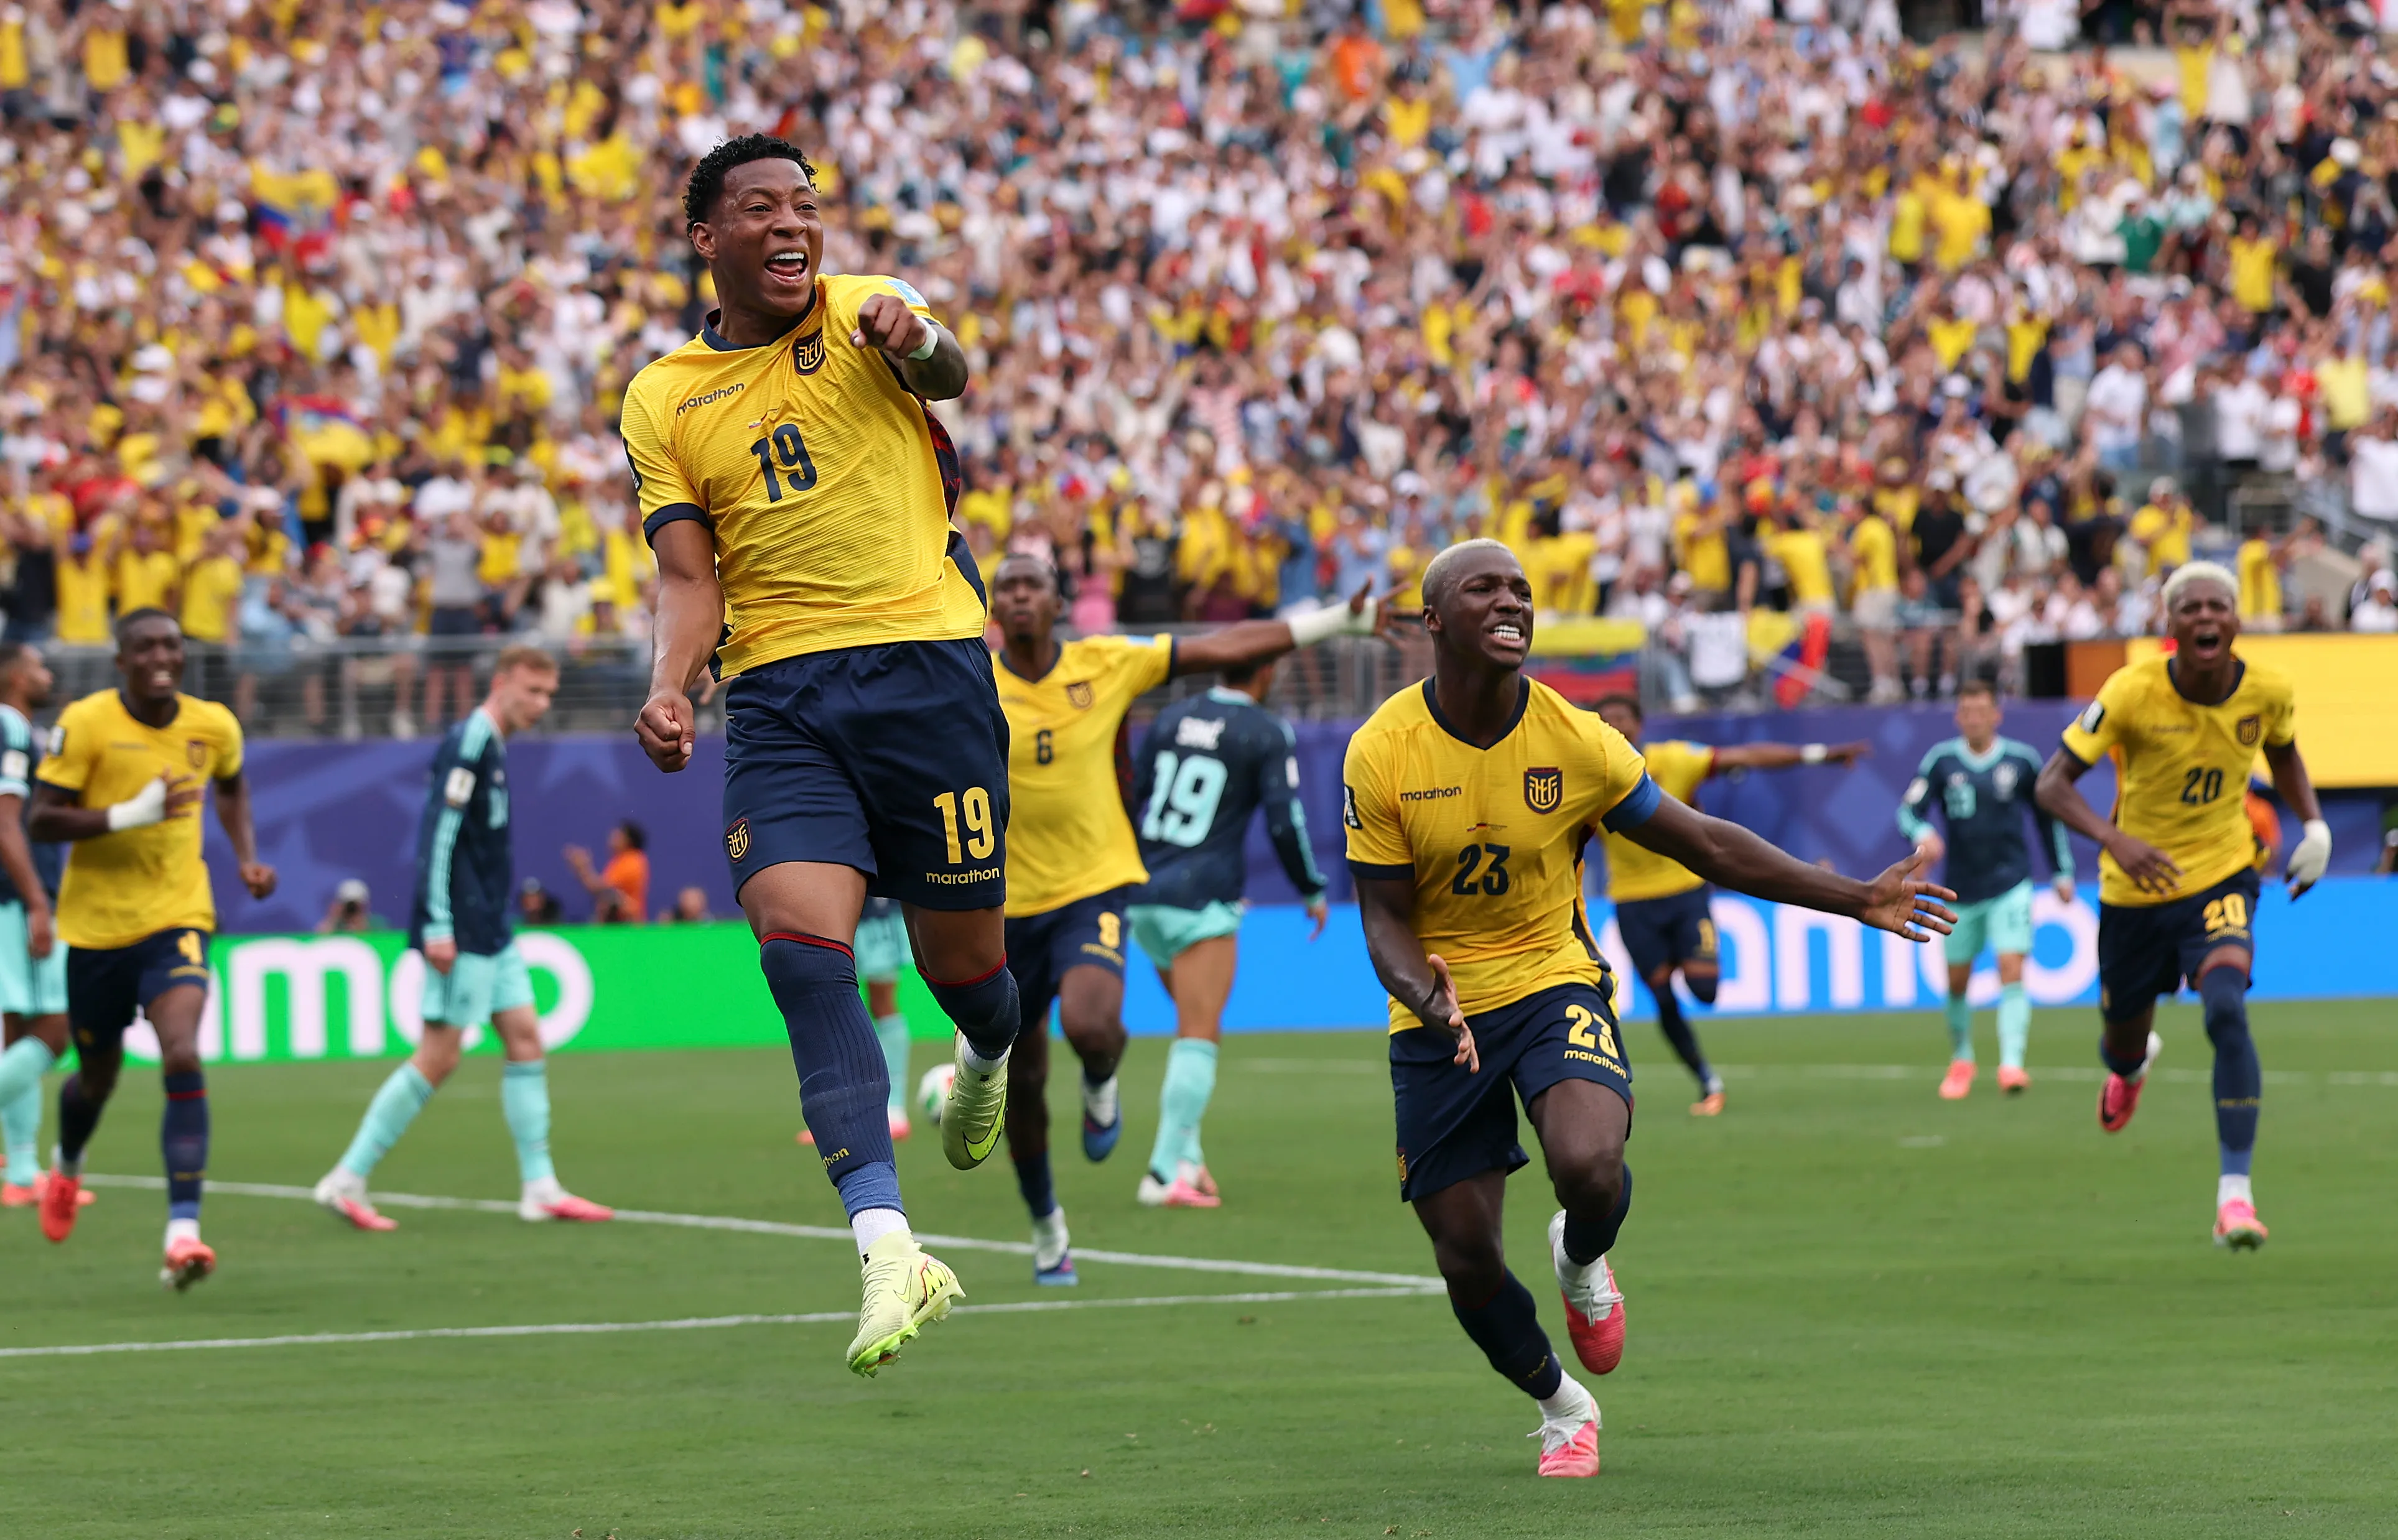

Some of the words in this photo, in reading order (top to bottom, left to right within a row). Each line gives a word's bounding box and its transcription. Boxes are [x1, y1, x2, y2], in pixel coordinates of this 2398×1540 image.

[676, 383, 745, 416] marathon
[750, 423, 817, 503] 19
[1036, 729, 1053, 766] 6
[1141, 749, 1229, 848] 19
[2181, 766, 2224, 805] 20
[933, 786, 995, 864] 19
[926, 867, 1000, 884] marathon
[1452, 842, 1510, 895] 23
[2203, 893, 2247, 932] 20
[1565, 1004, 1619, 1059] 23
[1563, 1049, 1627, 1079] marathon
